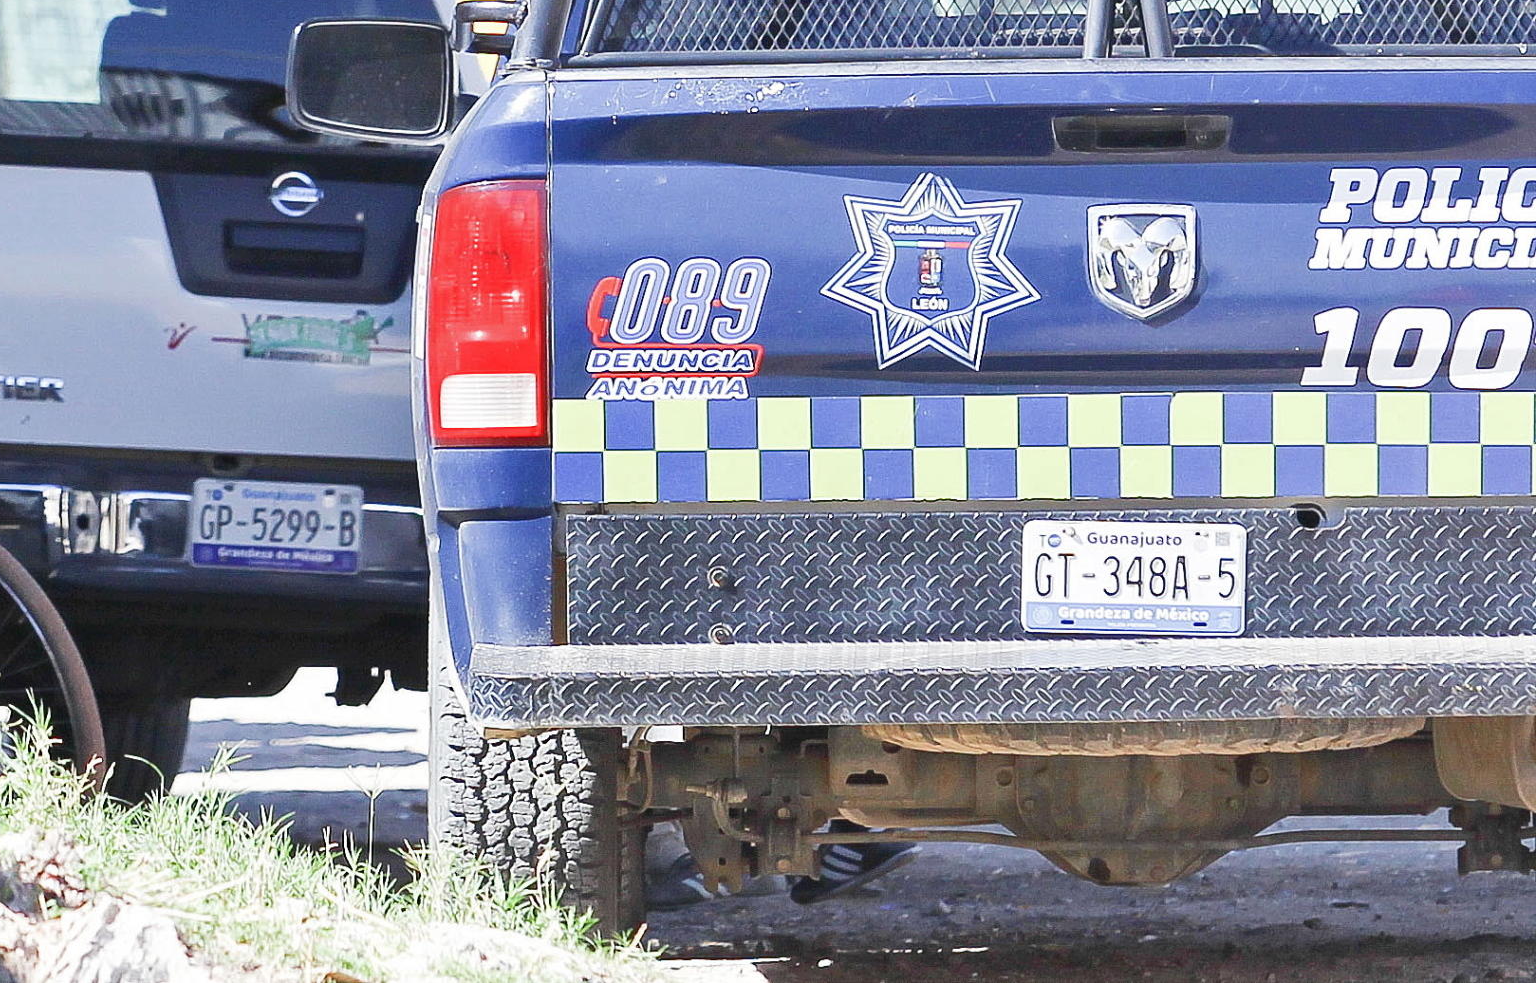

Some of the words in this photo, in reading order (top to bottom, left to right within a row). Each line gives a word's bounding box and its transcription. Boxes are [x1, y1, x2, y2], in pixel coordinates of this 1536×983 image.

[925, 225, 976, 236] MUNICIPAL
[609, 256, 772, 345] 089
[911, 296, 949, 311] LEÓN
[590, 351, 753, 370] DENUNCIA
[200, 504, 356, 546] GP-5299-B
[1087, 532, 1182, 547] Guanajuato
[1034, 553, 1236, 601] GT-348A-5
[1058, 606, 1131, 621] Grandeza
[1133, 607, 1153, 621] de
[1156, 608, 1210, 623] México
